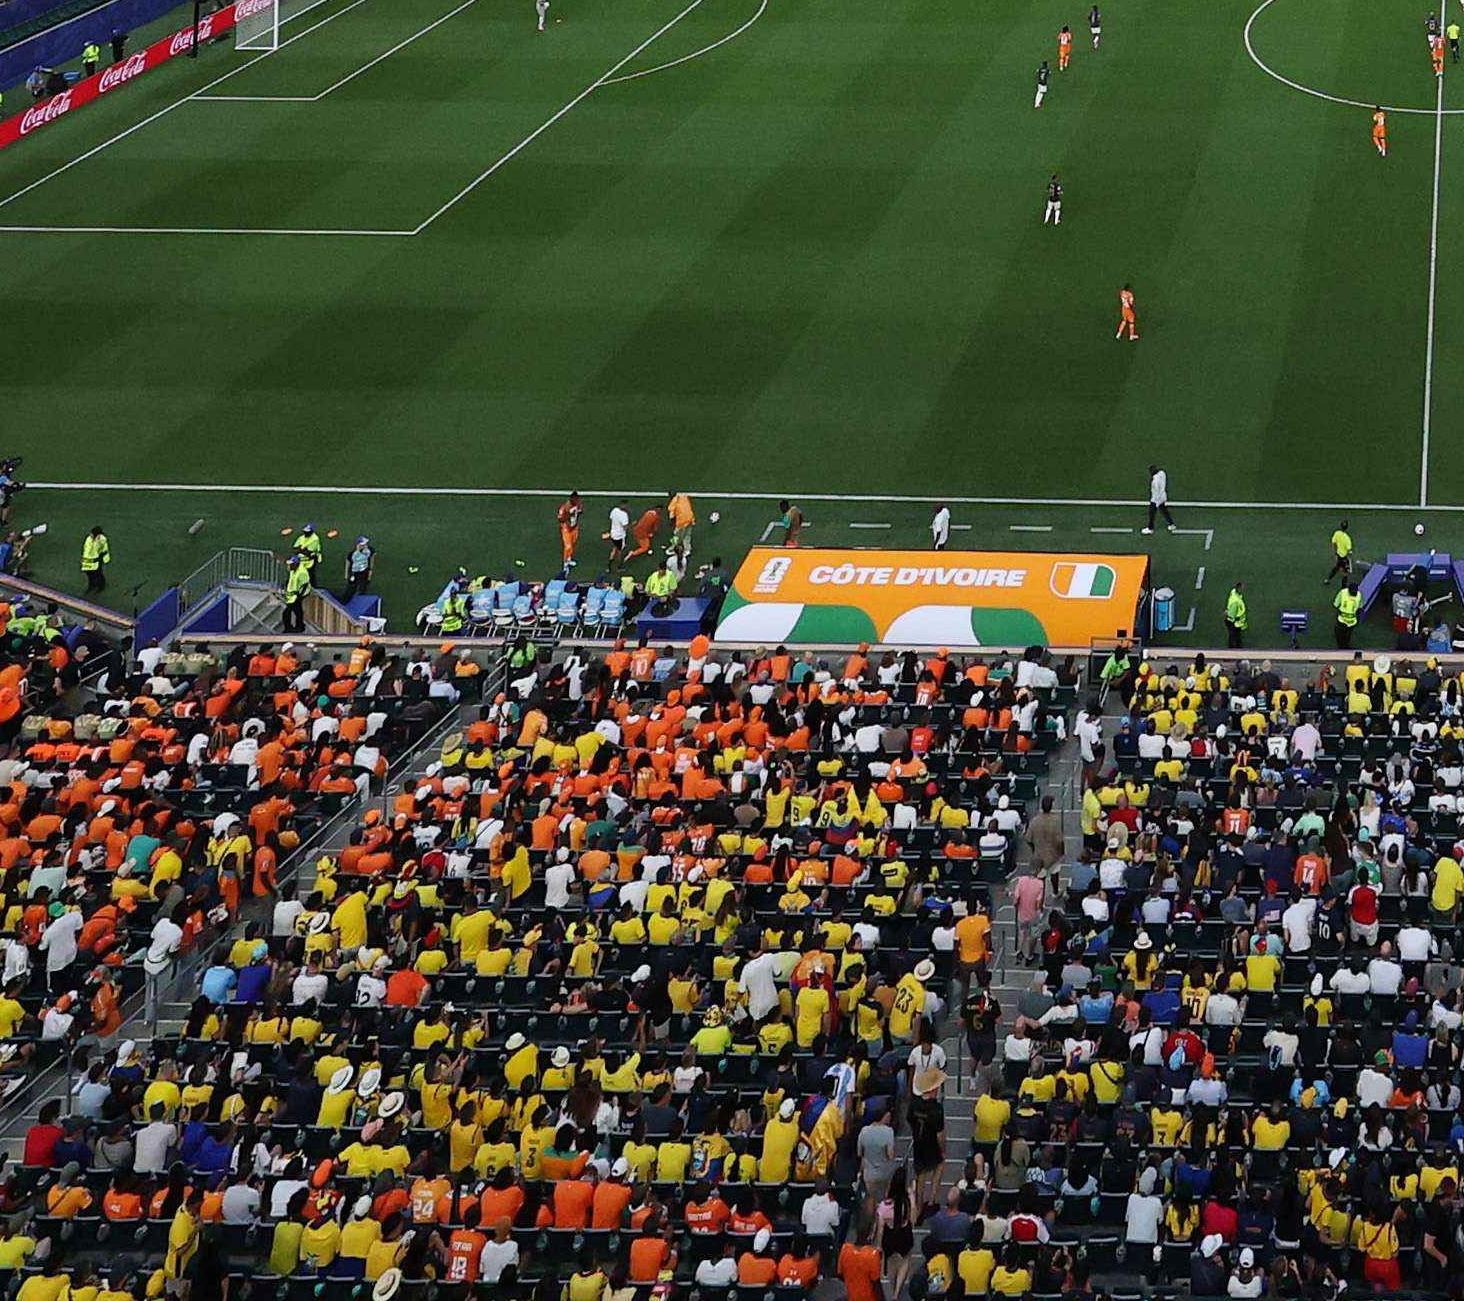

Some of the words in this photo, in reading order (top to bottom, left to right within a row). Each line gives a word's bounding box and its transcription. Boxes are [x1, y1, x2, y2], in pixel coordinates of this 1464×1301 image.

[808, 563, 892, 585] CÔTE
[894, 566, 1027, 587] D'IVOIRE
[412, 1198, 435, 1219] 24
